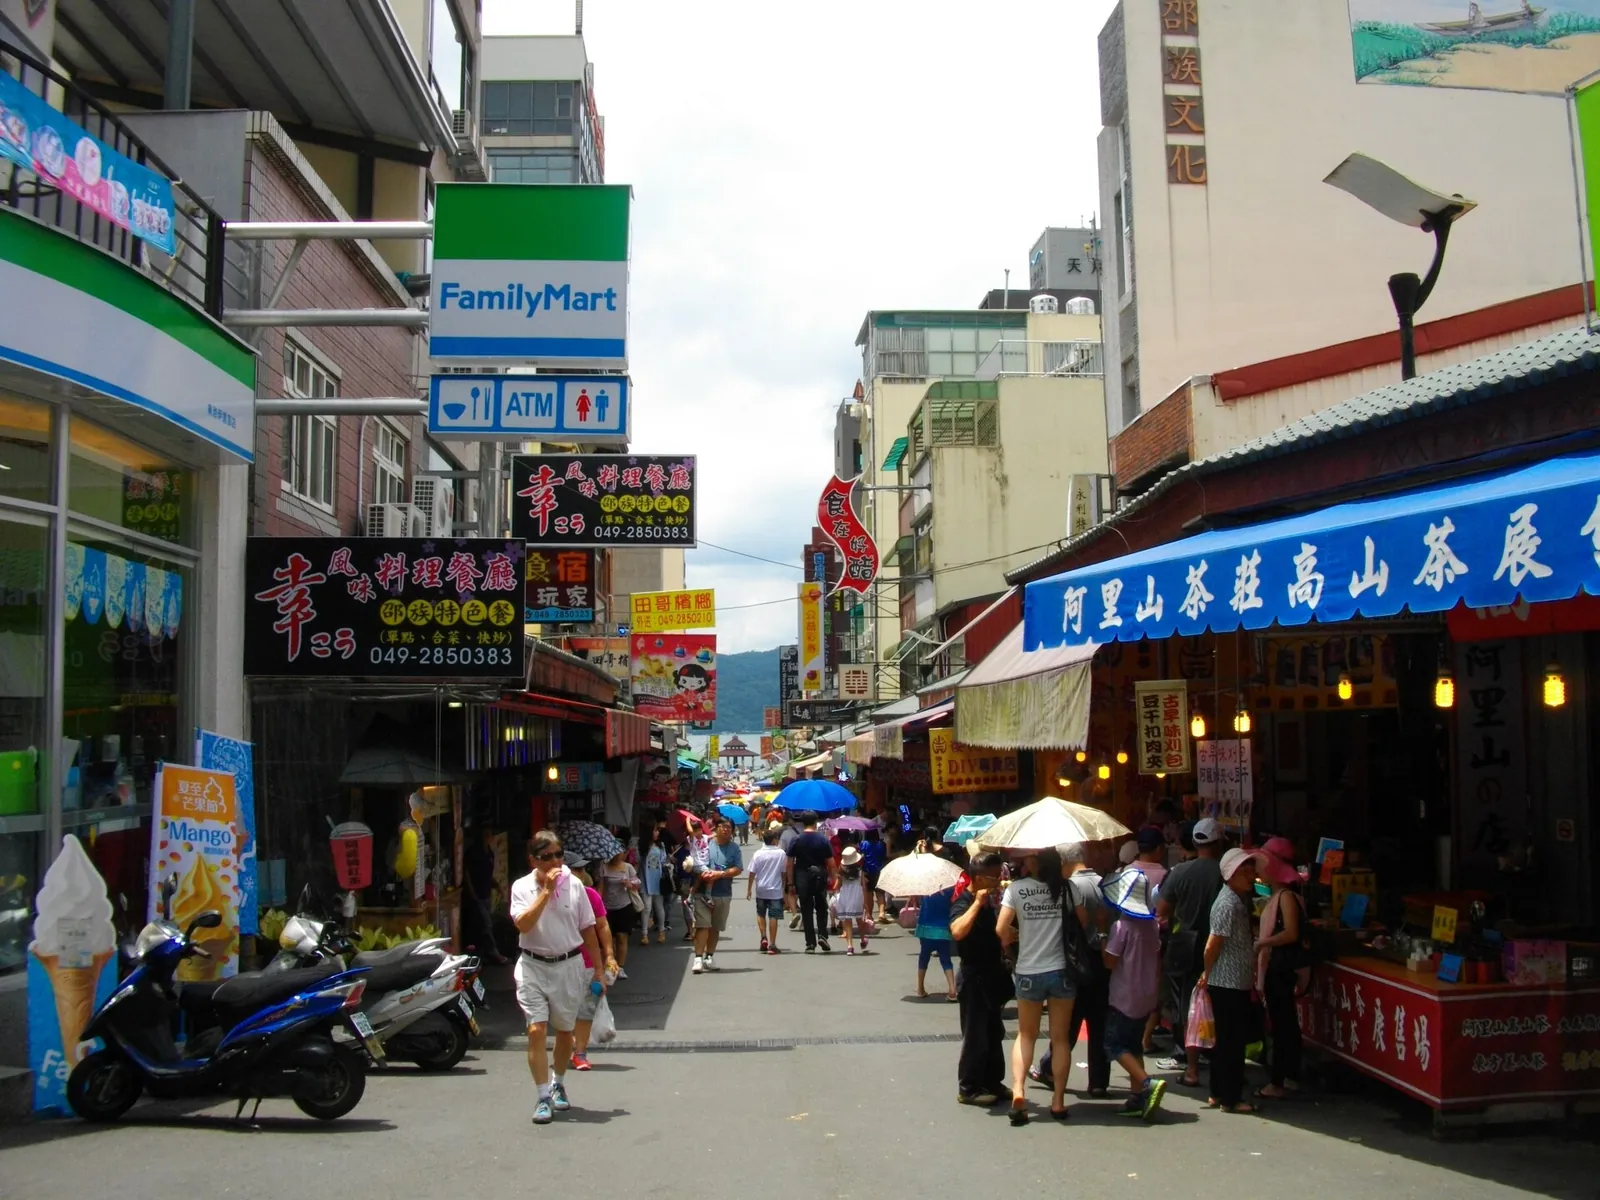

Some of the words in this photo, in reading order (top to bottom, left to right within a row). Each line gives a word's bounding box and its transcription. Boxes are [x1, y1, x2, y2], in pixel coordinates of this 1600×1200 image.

[1162, 0, 1207, 184] 邵族文化
[440, 282, 617, 318] FamilyMart
[505, 392, 553, 417] ATM
[517, 464, 565, 537] 幸
[601, 495, 689, 513] 邵族特色餐
[554, 514, 586, 535] こう
[594, 526, 688, 538] 049-2850383
[1062, 493, 1600, 635] 阿里山茶莊高山茶展
[254, 552, 327, 662] 幸
[537, 585, 588, 607] 玩家
[635, 592, 712, 613] 田哥檳榔
[381, 600, 515, 626] 邵族特色餐
[658, 612, 712, 626] 049-2850210
[310, 627, 357, 660] こう
[370, 647, 512, 664] 049-2850383
[1163, 694, 1183, 768] 古早味刈包
[170, 821, 231, 846] Mango
